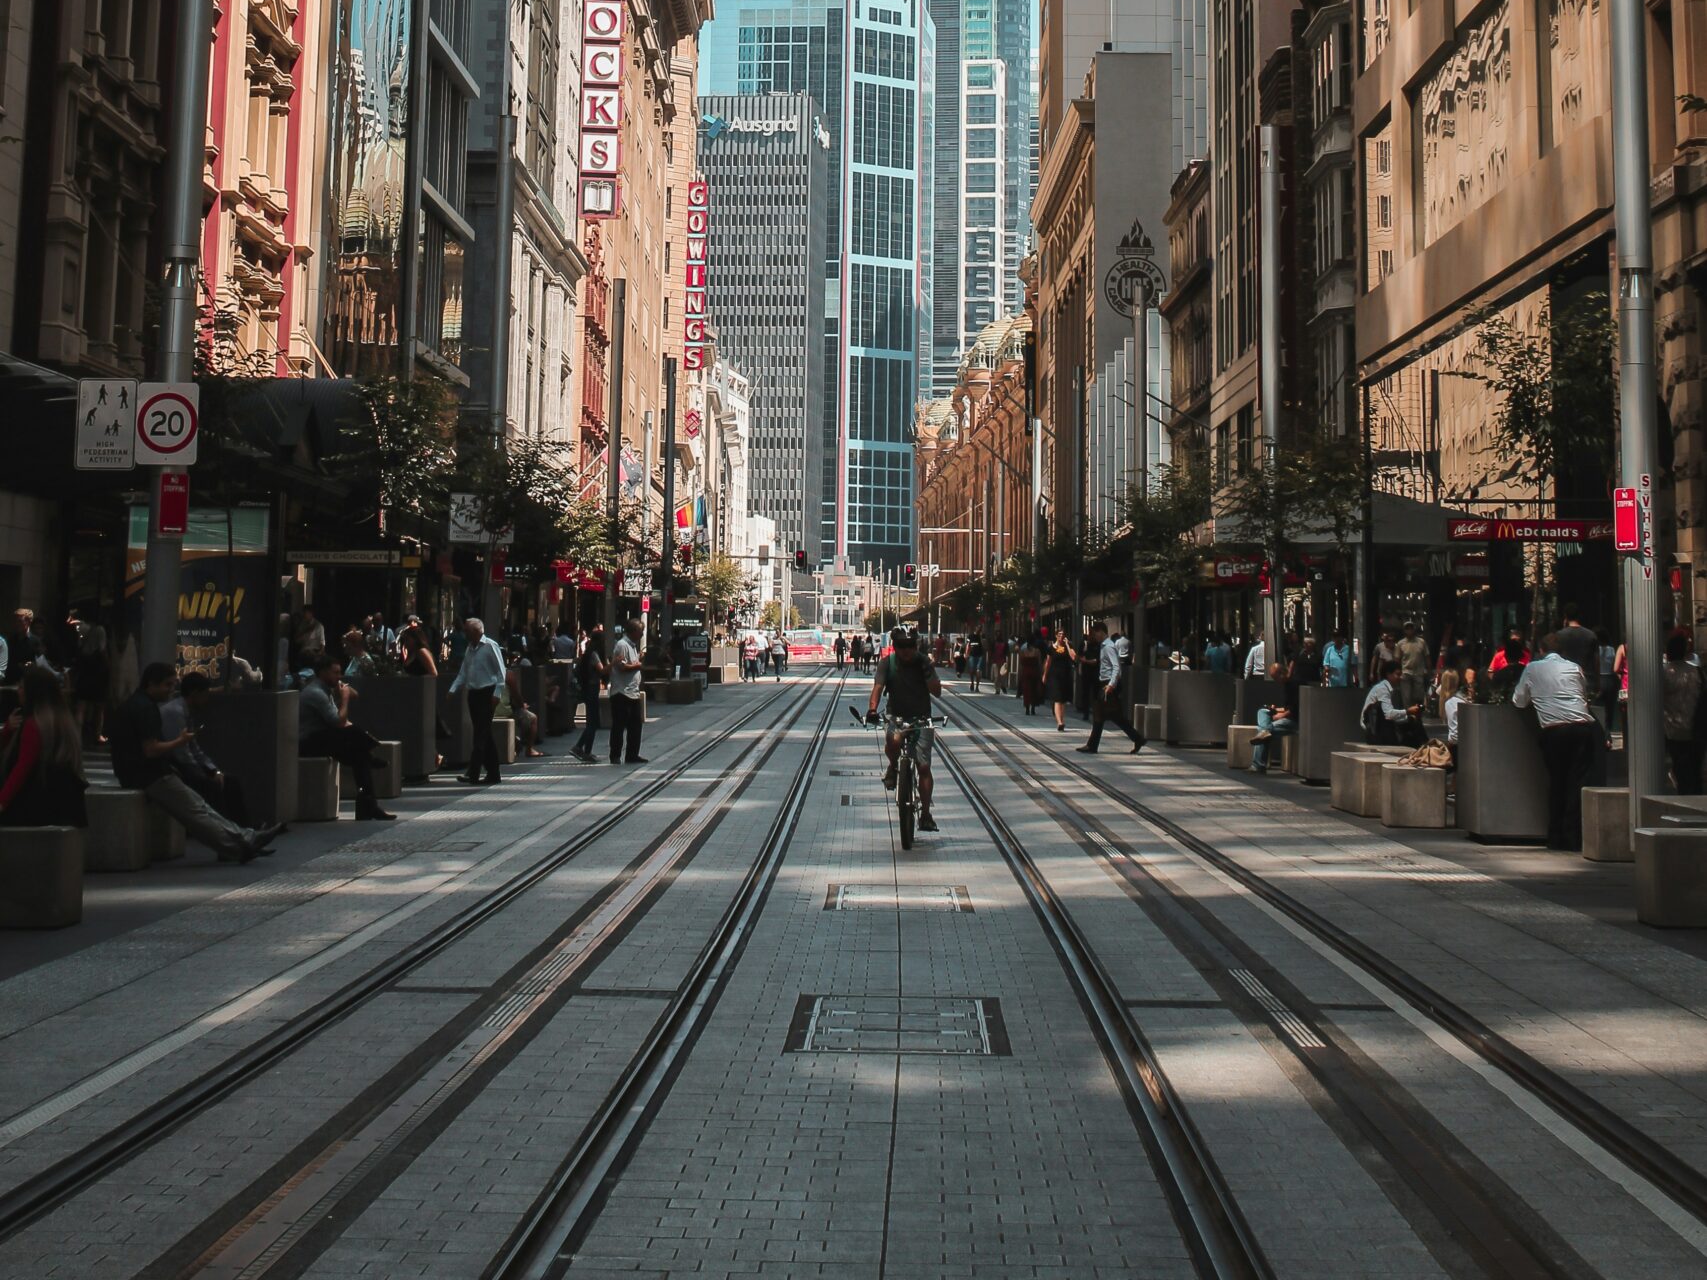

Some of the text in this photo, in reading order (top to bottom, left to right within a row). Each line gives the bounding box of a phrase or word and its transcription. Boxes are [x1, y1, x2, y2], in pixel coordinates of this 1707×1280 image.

[729, 114, 798, 136] Ausgrid
[685, 184, 705, 369] GOWINGS
[1116, 260, 1155, 275] HEALTH
[1108, 287, 1128, 313] CARE
[150, 410, 185, 436] 20
[191, 628, 211, 637] with
